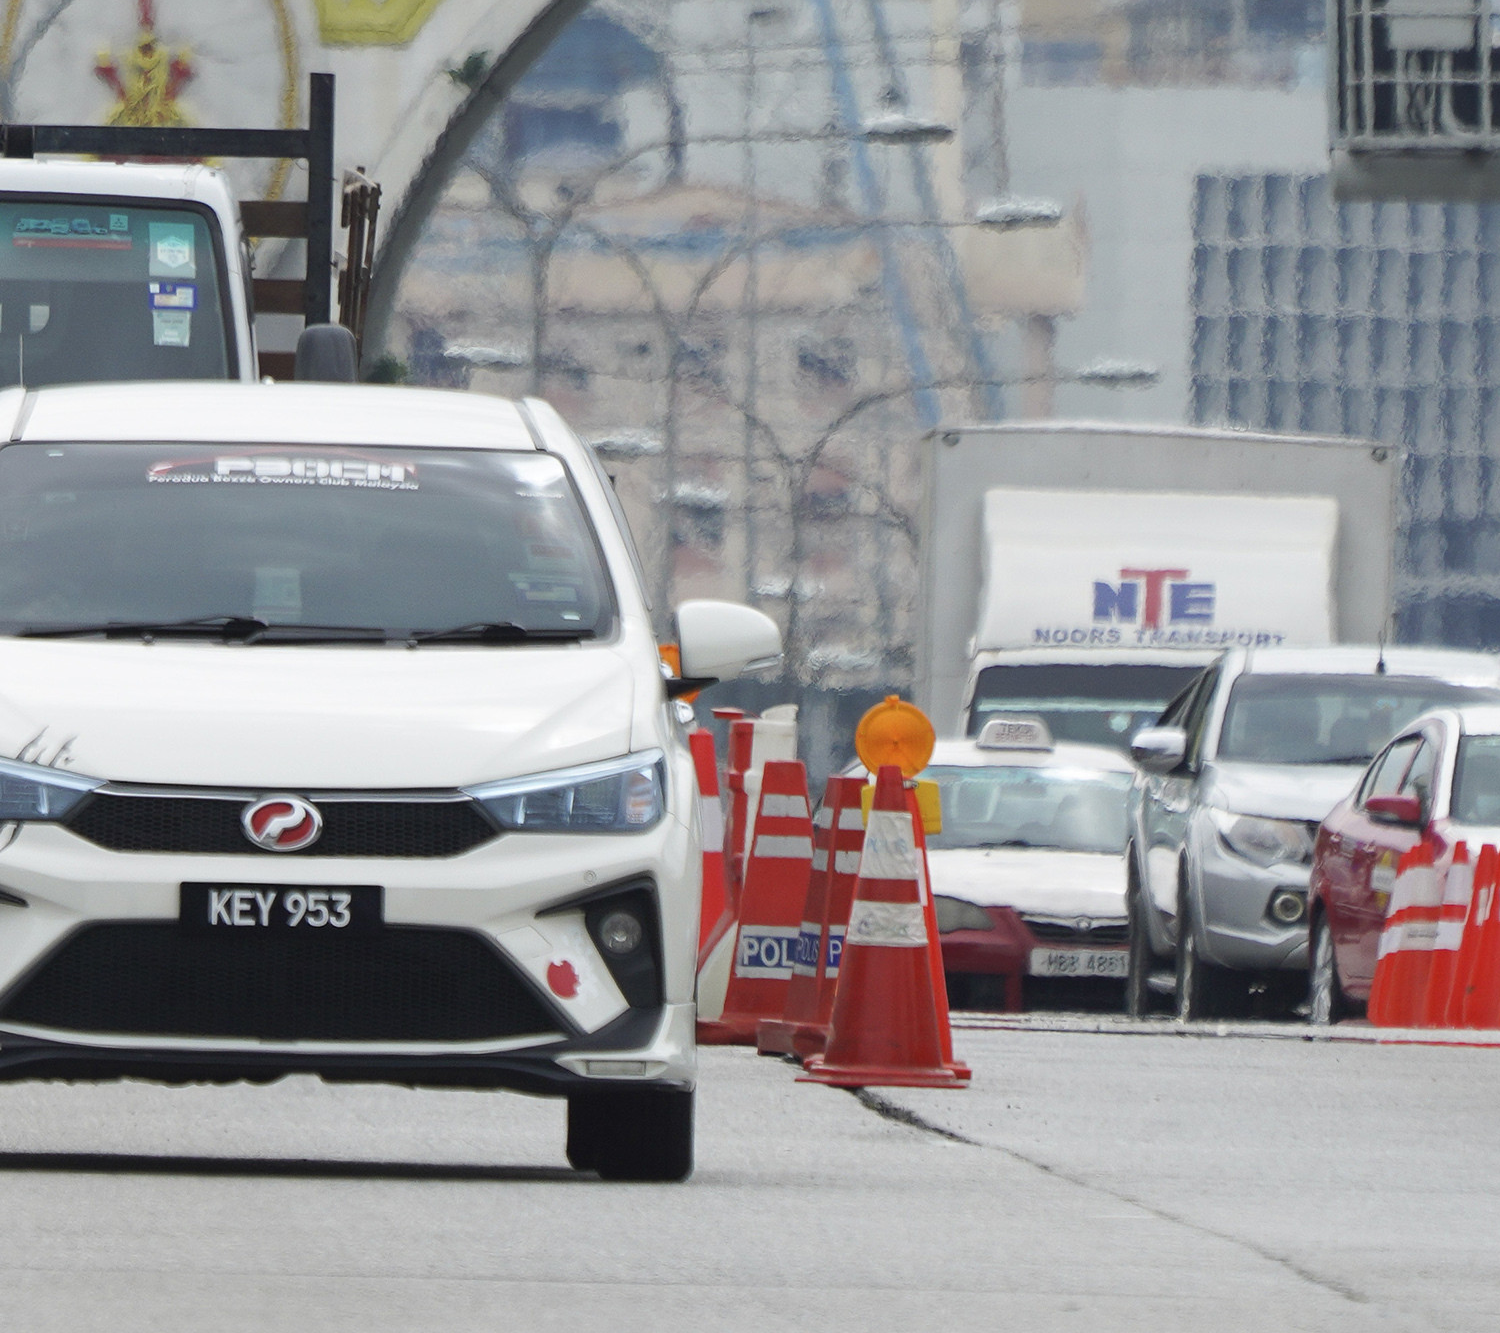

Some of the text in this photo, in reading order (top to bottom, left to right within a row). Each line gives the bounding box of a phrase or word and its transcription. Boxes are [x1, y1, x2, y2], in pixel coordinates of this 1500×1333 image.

[149, 475, 209, 484] Perodua
[260, 476, 315, 485] Owners
[319, 476, 350, 486] Club
[354, 480, 419, 491] Malaysia
[1093, 568, 1216, 630] NTE
[1034, 628, 1286, 646] NOORS TRANSPORT
[208, 889, 352, 928] KEY 953
